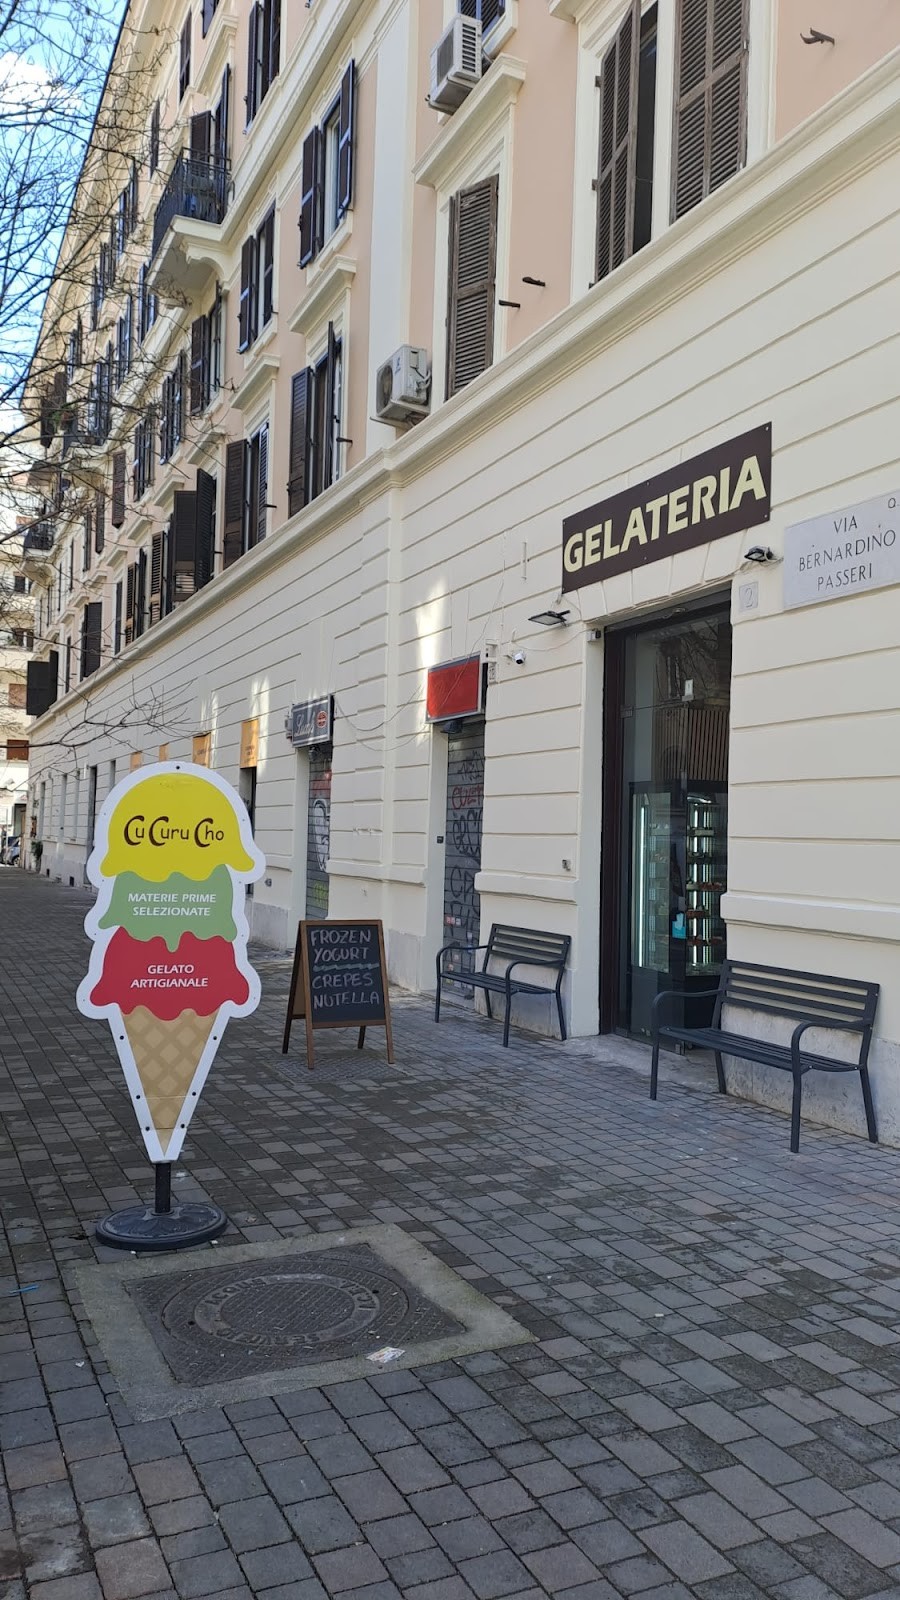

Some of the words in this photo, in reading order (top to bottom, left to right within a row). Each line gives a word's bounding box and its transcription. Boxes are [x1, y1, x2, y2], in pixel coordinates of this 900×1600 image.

[563, 455, 767, 573] GELATERIA
[833, 515, 858, 534] VIA
[799, 529, 897, 573] BERNARDINO
[817, 563, 873, 592] PASSERI
[127, 893, 178, 903] MATERIE
[182, 893, 217, 904] PRIME
[132, 907, 211, 917] SELEZIONATE
[310, 929, 371, 947] FROZEN
[313, 946, 370, 964] YOGURT
[147, 964, 195, 974] GELATO
[130, 977, 209, 989] ARTIGIANALE
[312, 972, 374, 990] CREPES
[313, 991, 380, 1010] NUTELLA
